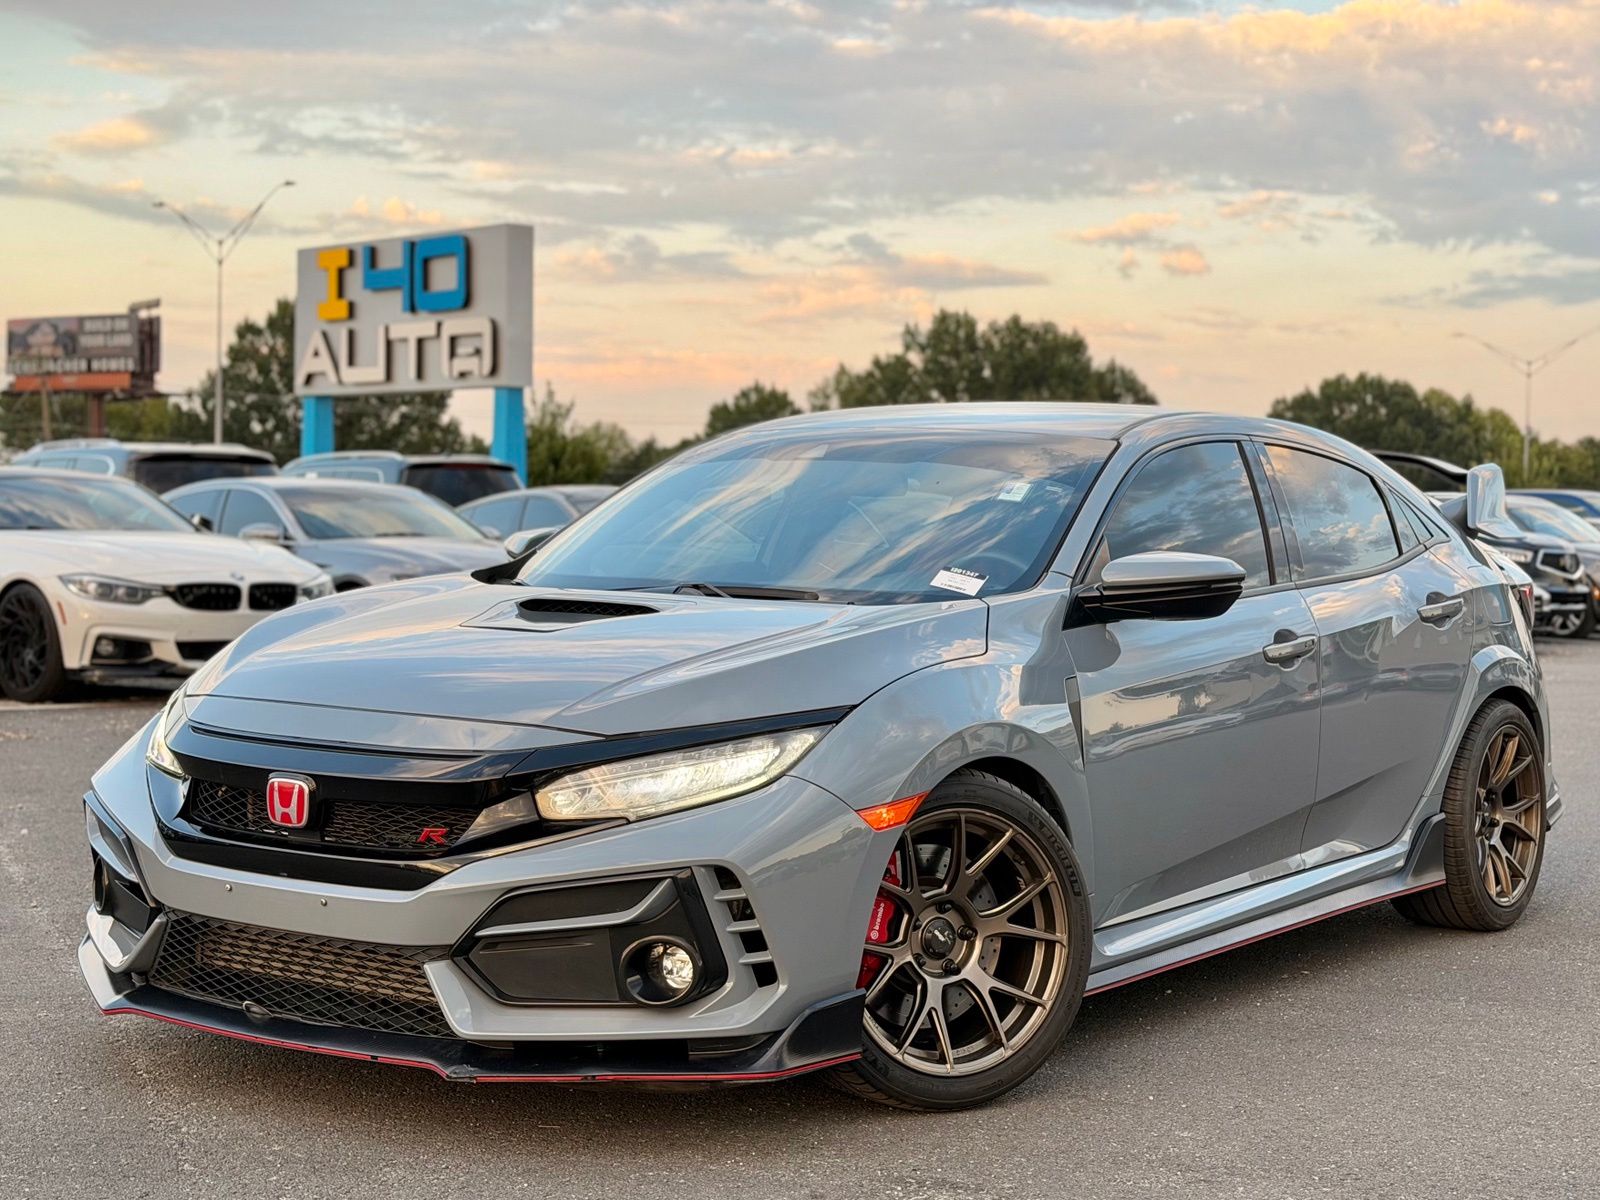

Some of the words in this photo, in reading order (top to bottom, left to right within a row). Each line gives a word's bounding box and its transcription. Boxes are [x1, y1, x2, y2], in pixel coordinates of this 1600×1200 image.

[299, 317, 494, 386] AUTO
[416, 827, 448, 844] R
[873, 902, 885, 931] brembo
